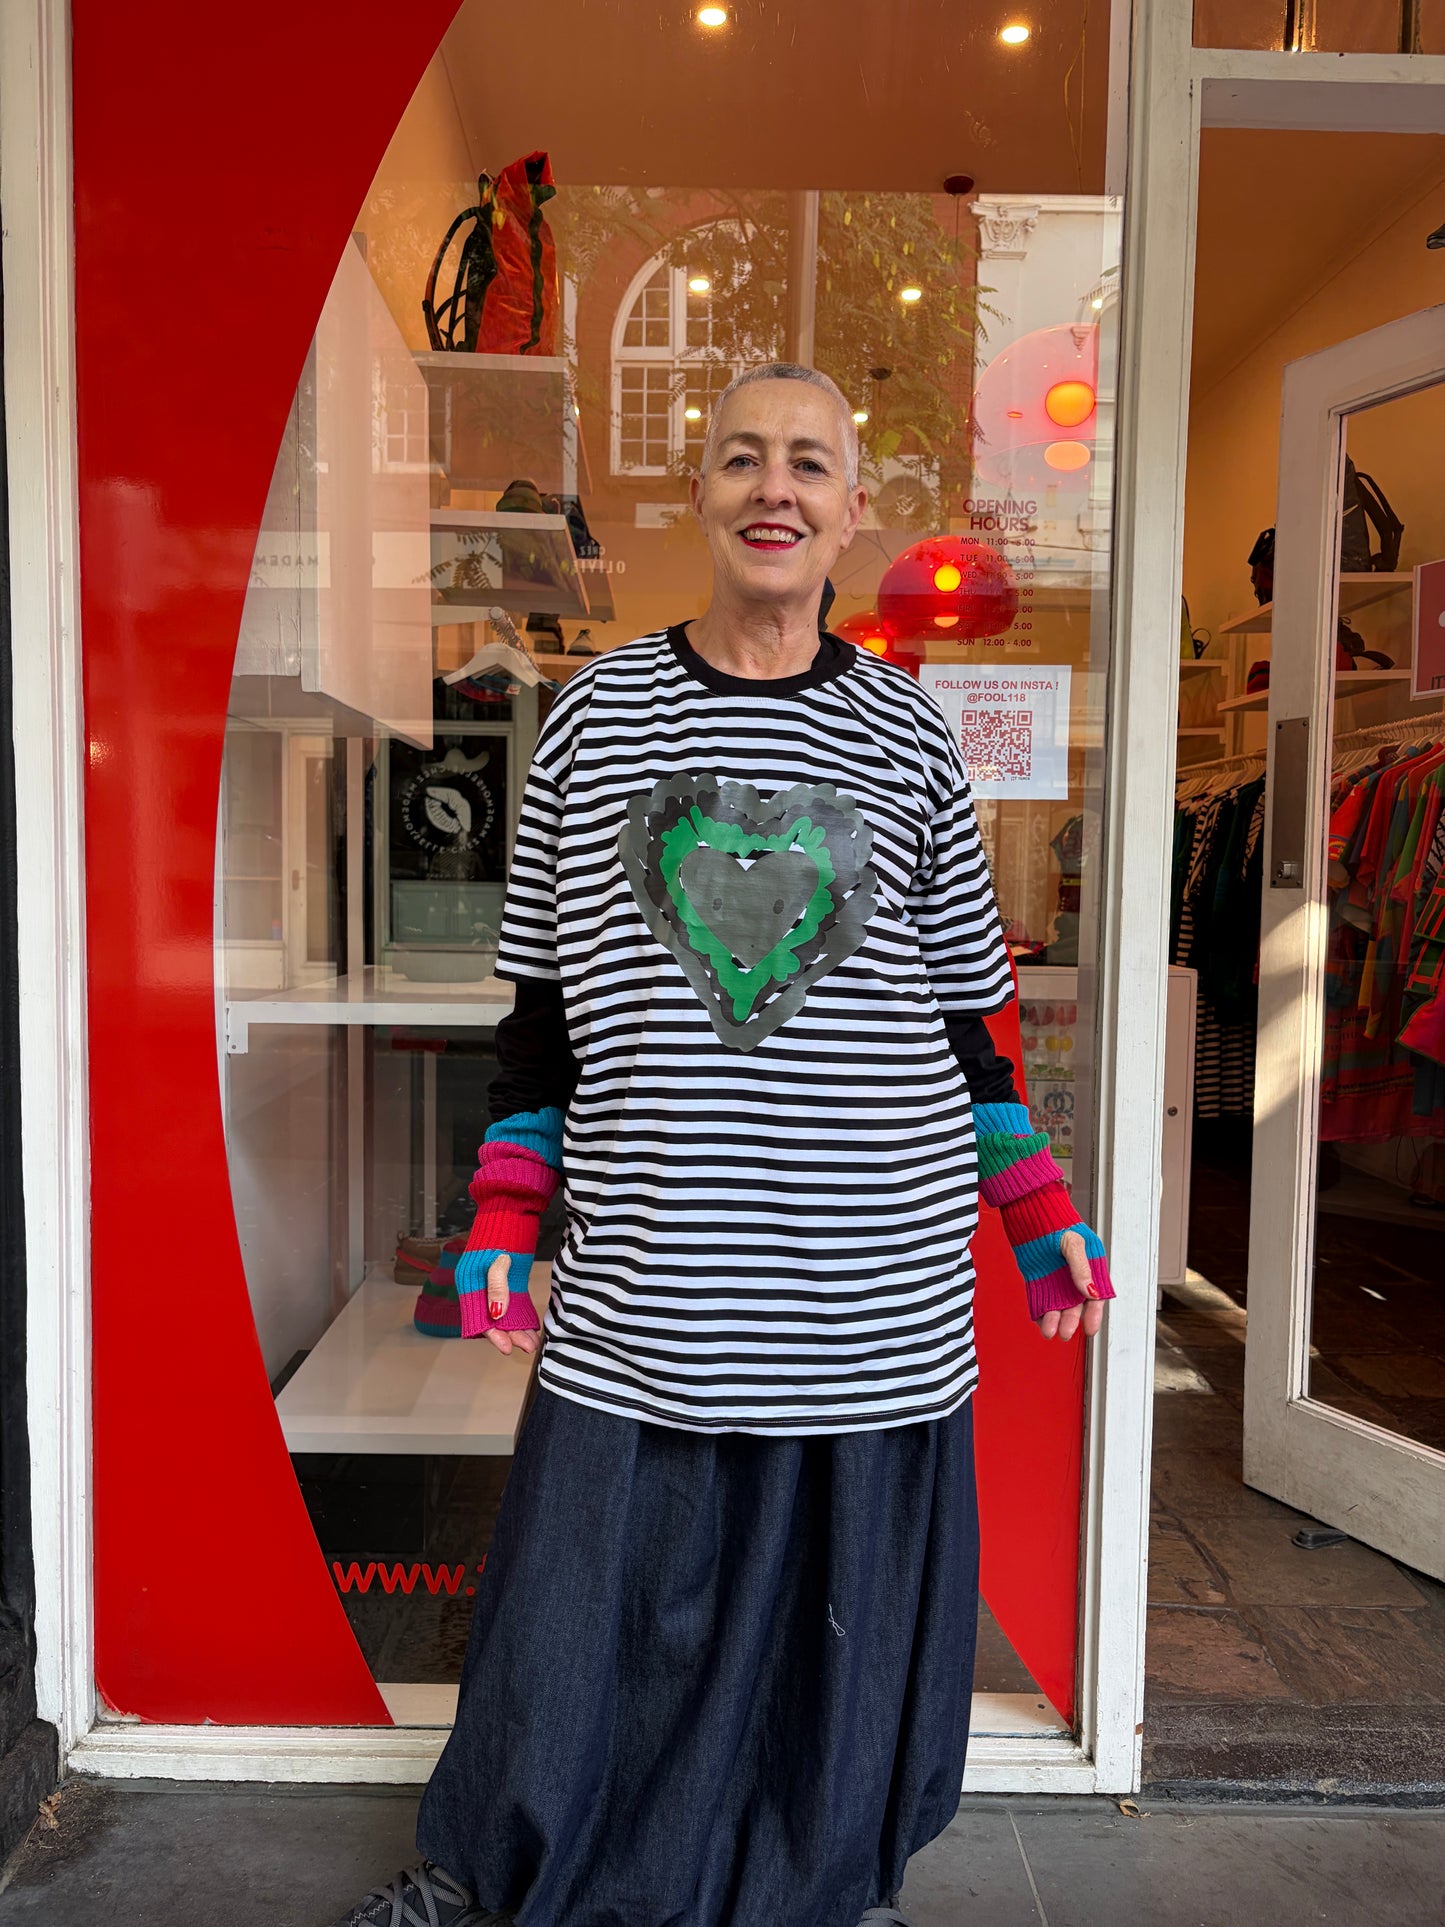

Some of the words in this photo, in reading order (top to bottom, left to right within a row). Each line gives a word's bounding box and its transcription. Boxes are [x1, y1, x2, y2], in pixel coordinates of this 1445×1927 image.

[963, 499, 1038, 514] OPENING
[970, 516, 1029, 531] HOURS
[960, 537, 980, 545] MON
[986, 537, 1009, 546] 11:00
[960, 554, 978, 562] TUE
[961, 571, 977, 579] WED
[1015, 572, 1035, 581] 5:00
[1014, 622, 1033, 630] 5:00
[957, 638, 975, 646] SUN
[983, 638, 1005, 647] 12:00
[1013, 639, 1032, 647] 4:00
[935, 680, 982, 690] FOLLOW
[983, 680, 999, 690] US
[1001, 680, 1018, 690] ON
[1020, 681, 1053, 691] INSTA
[966, 692, 1026, 704] @FOOL118
[332, 1552, 488, 1596] www.
